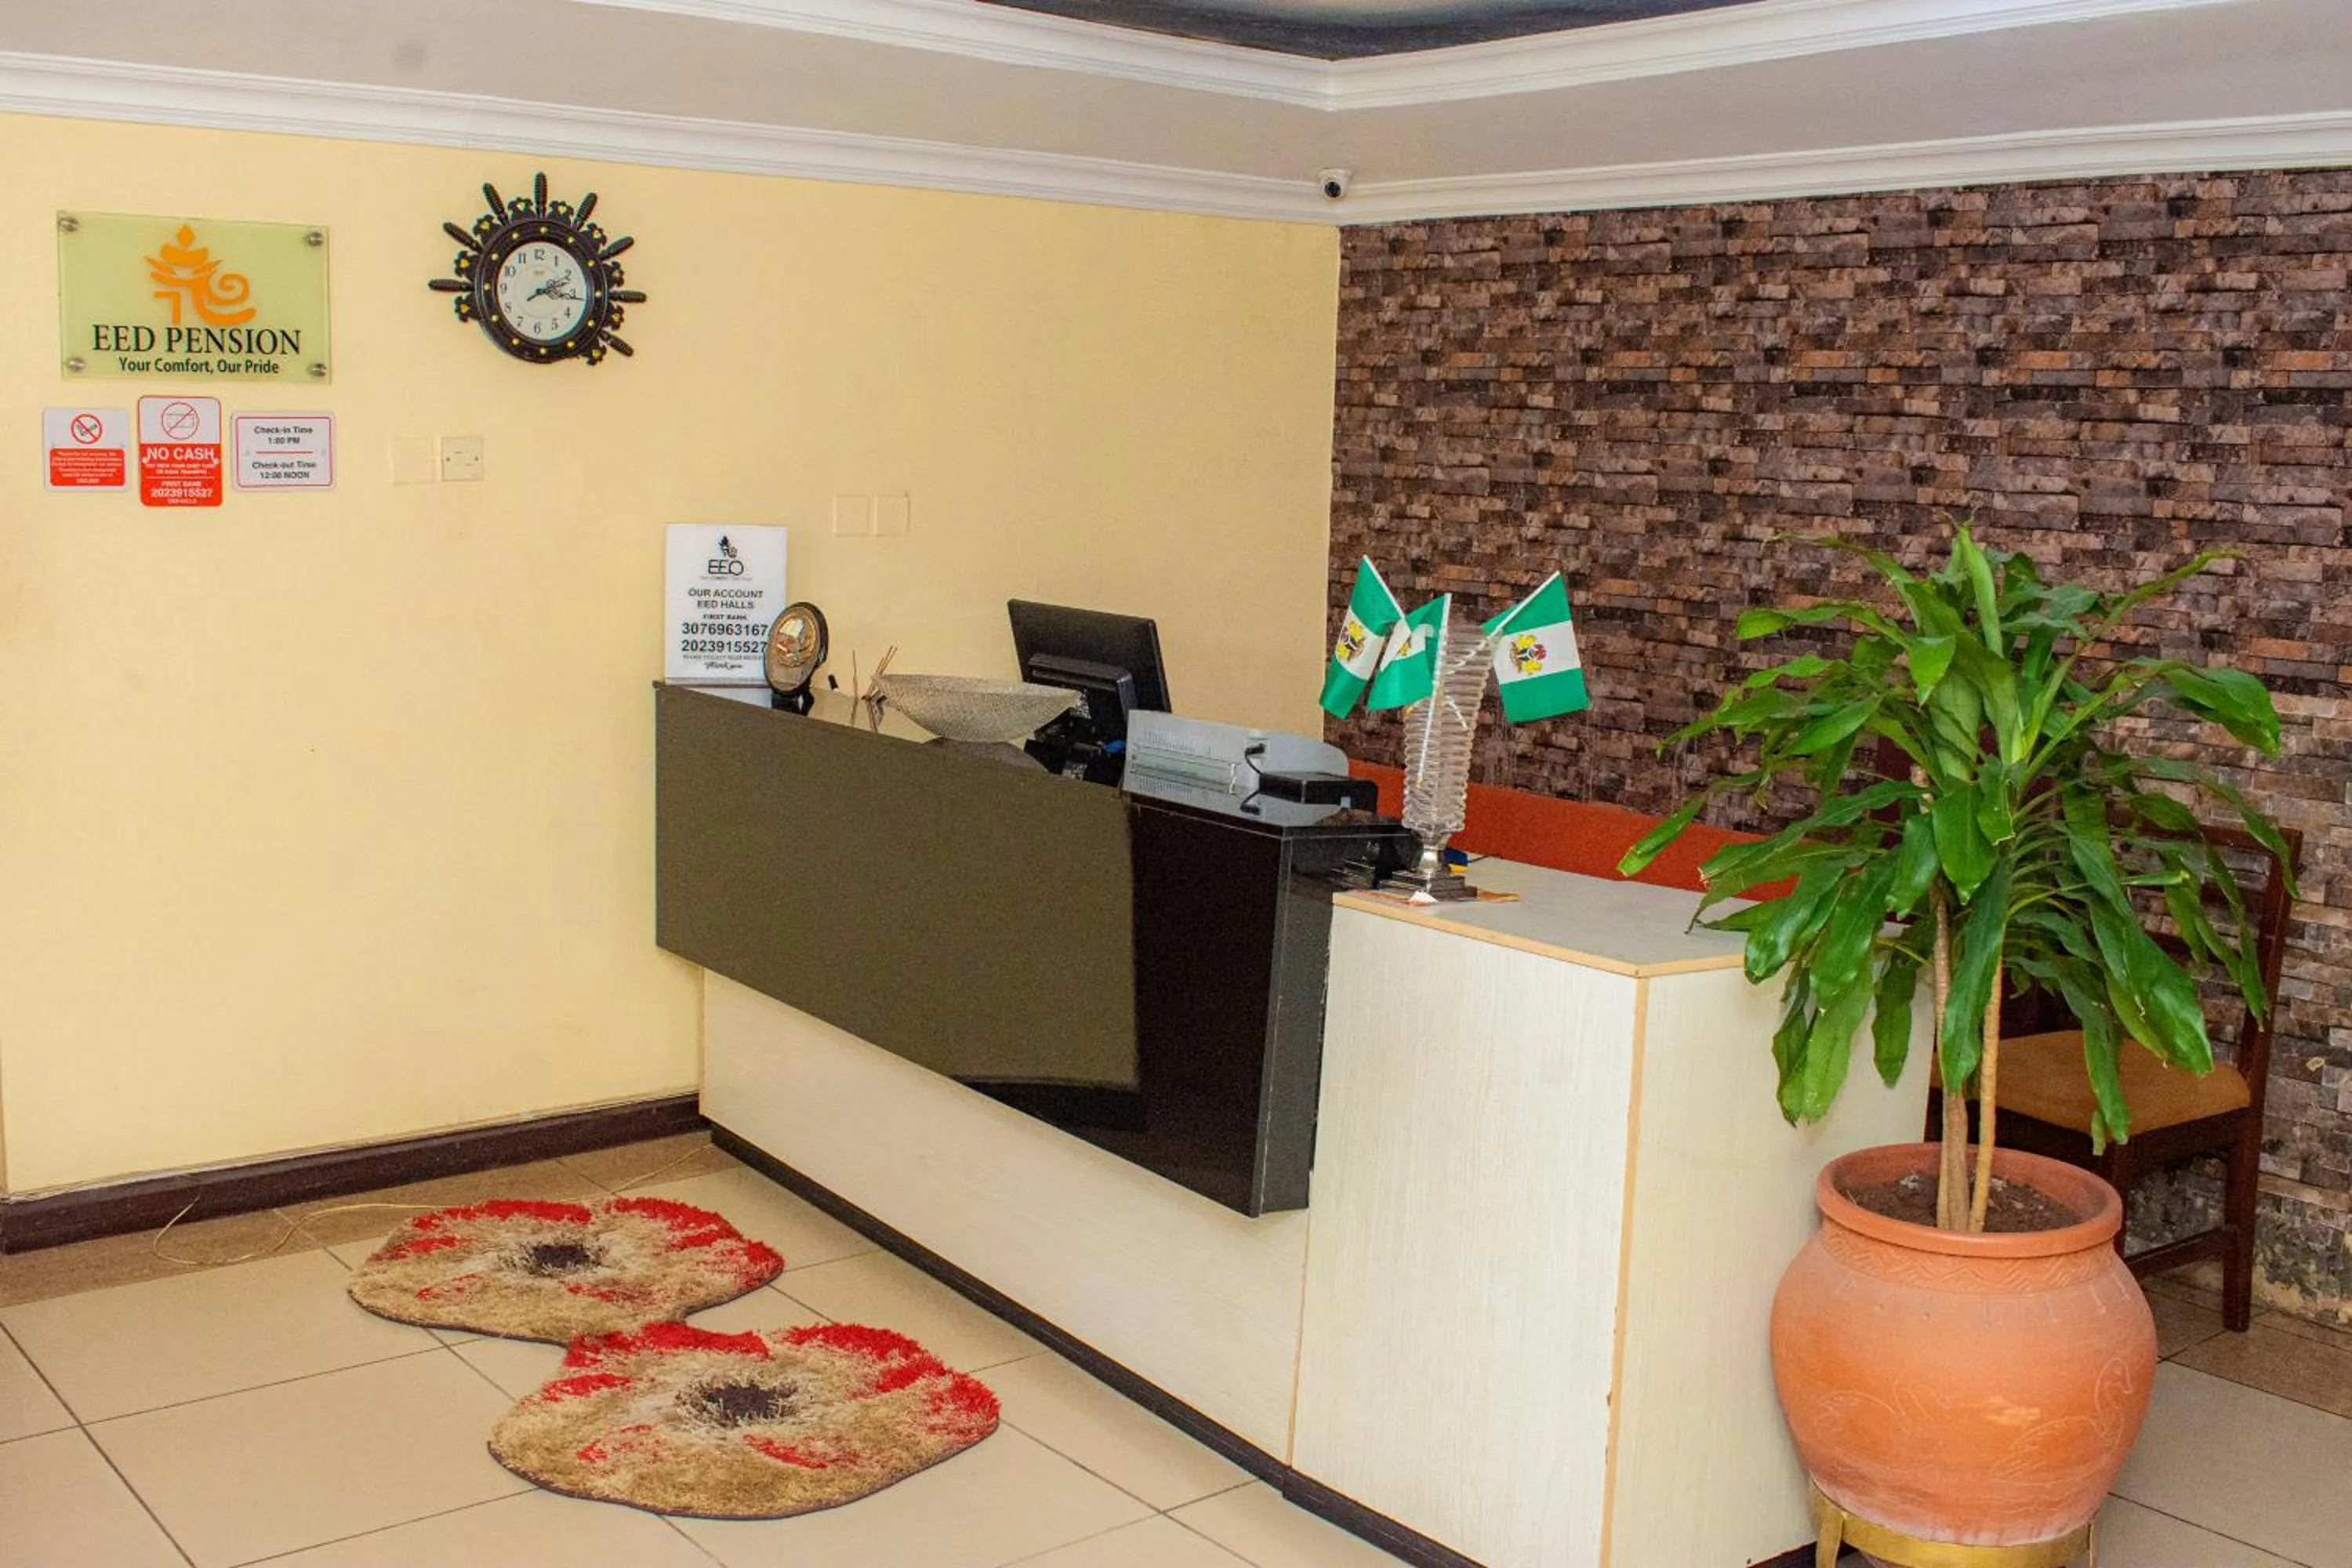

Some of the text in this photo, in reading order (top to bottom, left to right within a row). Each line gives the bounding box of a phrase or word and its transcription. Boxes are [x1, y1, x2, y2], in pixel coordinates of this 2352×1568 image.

[518, 252, 526, 263] 11
[535, 249, 545, 261] 12
[504, 265, 516, 277] 10
[564, 269, 572, 281] 2
[500, 282, 507, 294] 9
[504, 301, 512, 314] 8
[564, 307, 571, 318] 4
[517, 316, 524, 327] 7
[552, 318, 558, 330] 5
[534, 321, 542, 335] 6
[93, 324, 302, 355] EED PENSION
[118, 357, 280, 374] Your Comfort, Our Pride
[147, 447, 214, 461] NO CASH
[688, 588, 764, 598] OUR ACCOUNT
[697, 600, 753, 609] EED HALLS
[682, 622, 768, 636] 3076963167
[681, 639, 768, 653] 2023915527
